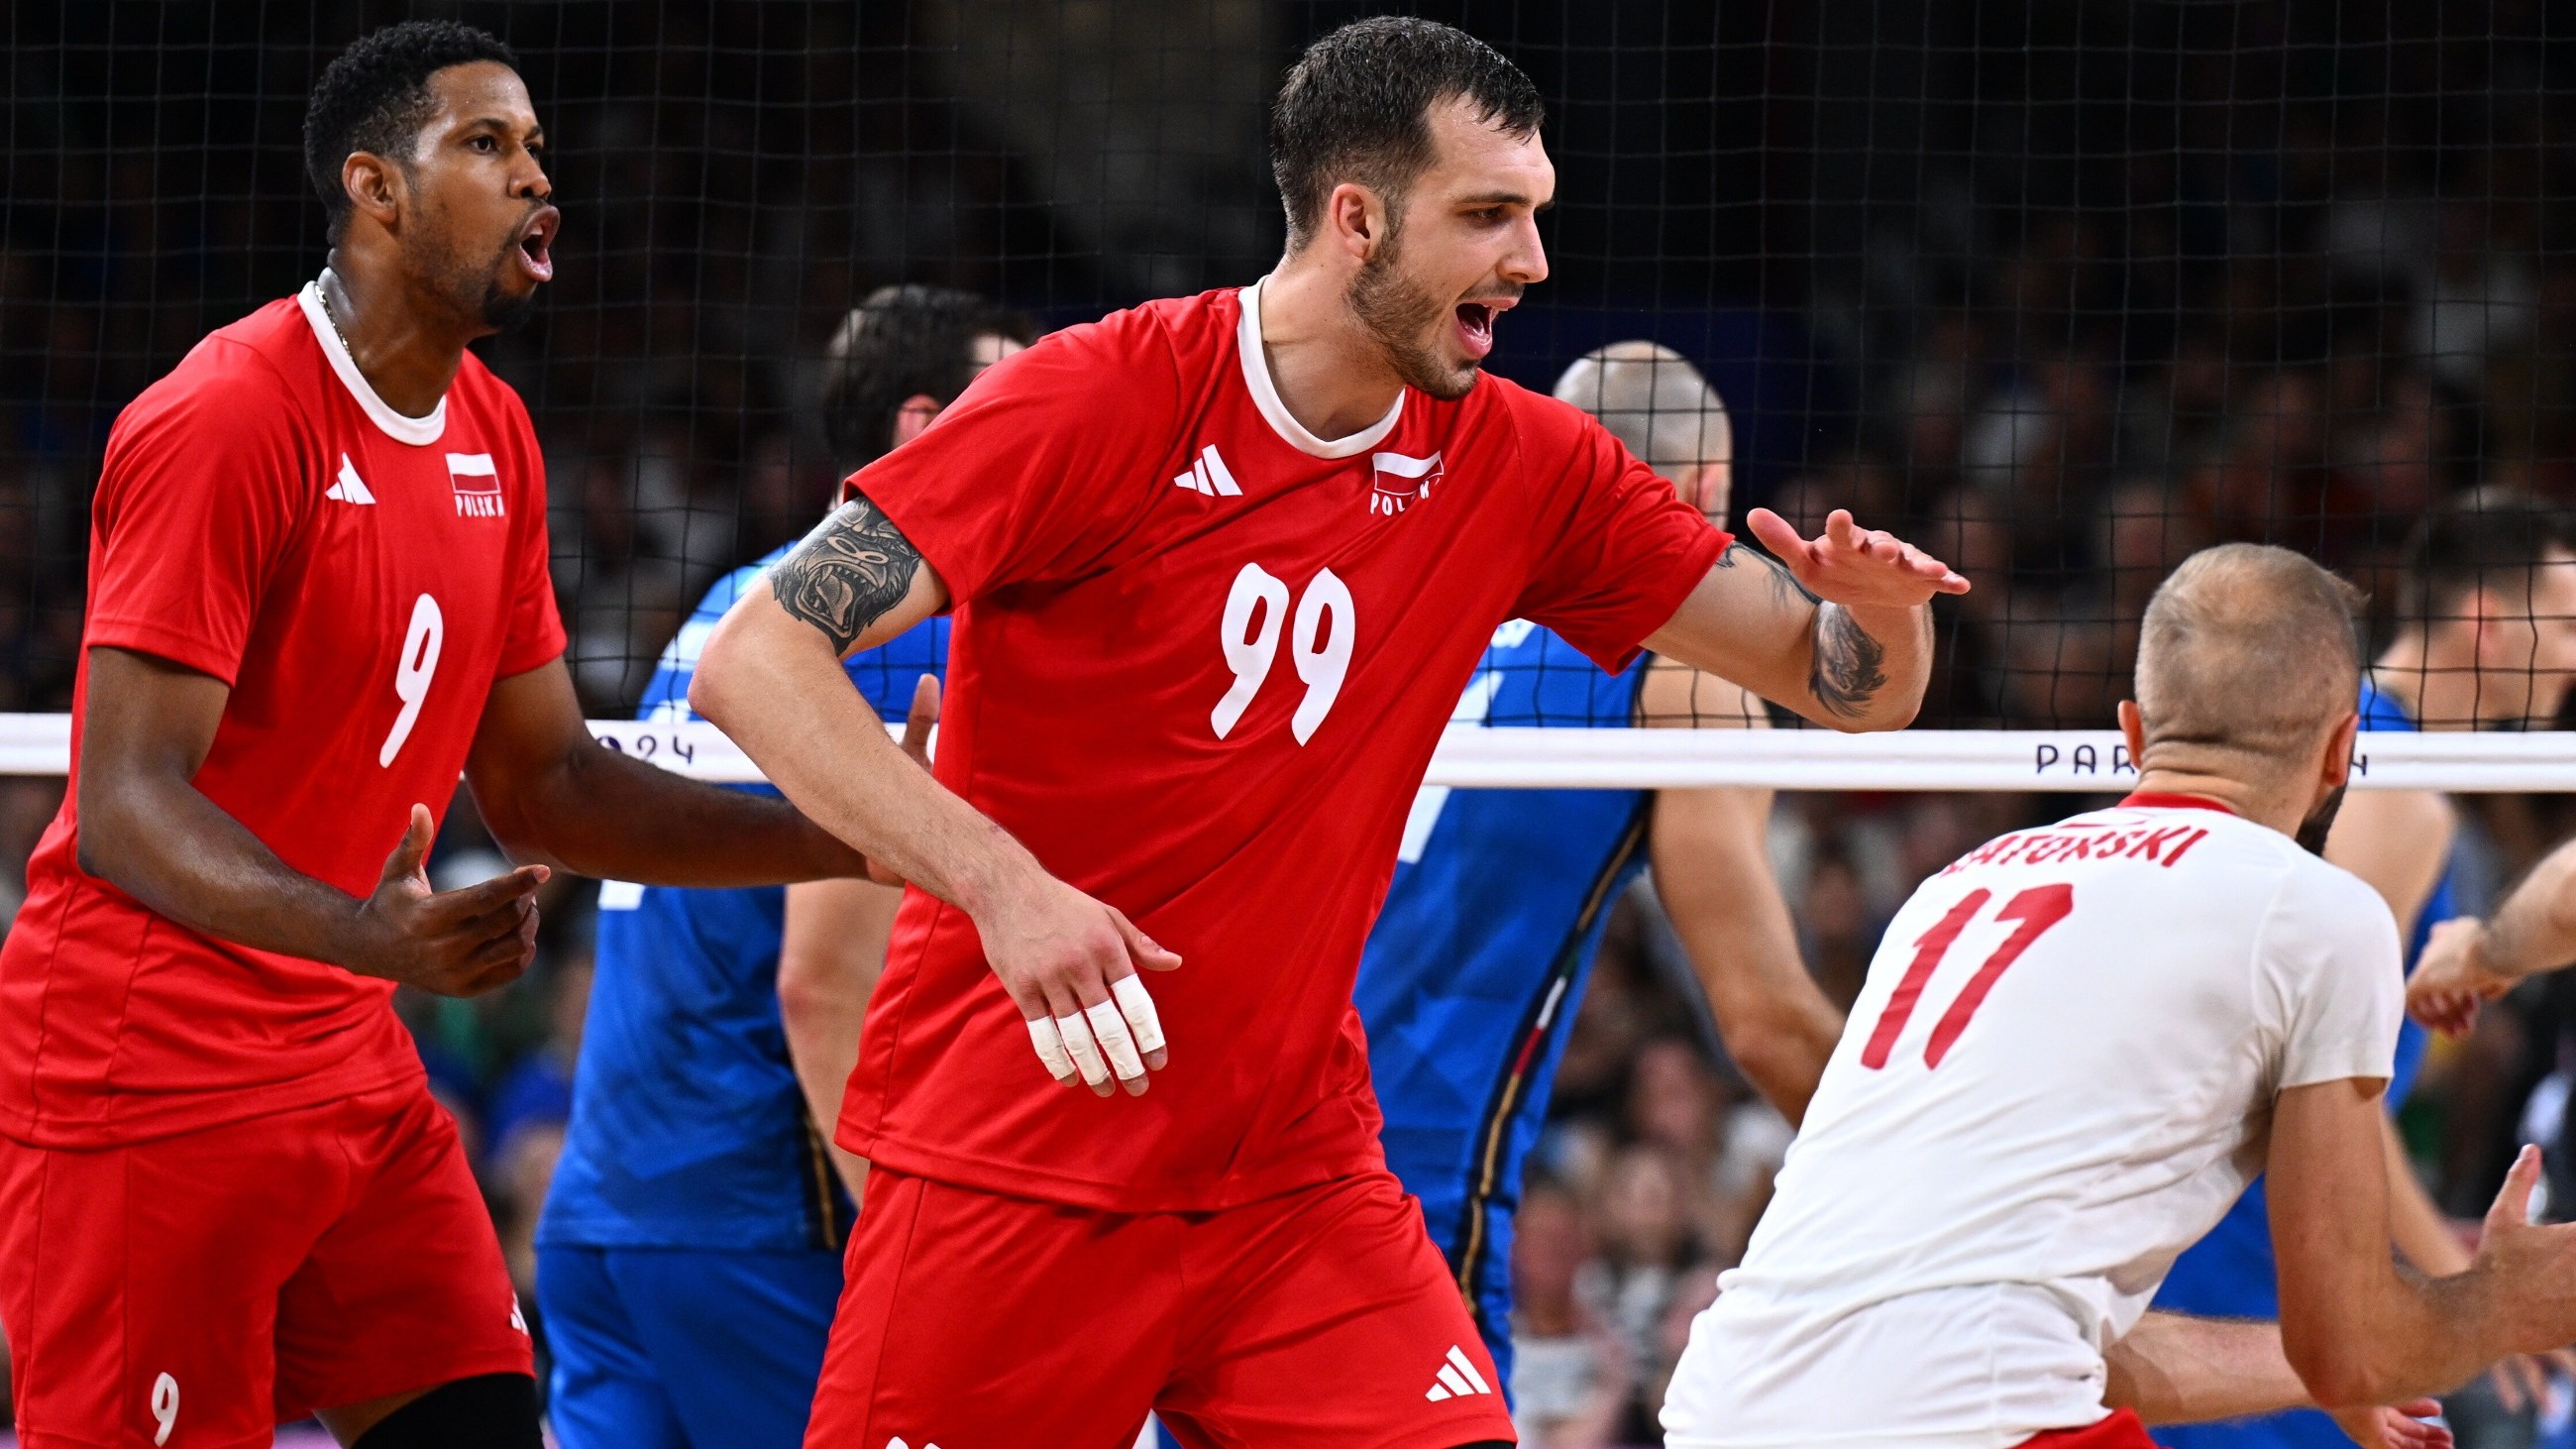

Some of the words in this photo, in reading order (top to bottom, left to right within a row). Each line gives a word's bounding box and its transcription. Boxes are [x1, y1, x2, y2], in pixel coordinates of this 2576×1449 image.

[1370, 477, 1441, 516] POLK
[379, 593, 443, 768] 9
[1211, 562, 1355, 747] 99
[2036, 744, 2135, 774] PAR
[1939, 826, 2208, 878] ATORSKI
[1861, 883, 2073, 1070] 17
[152, 1372, 179, 1448] 9
